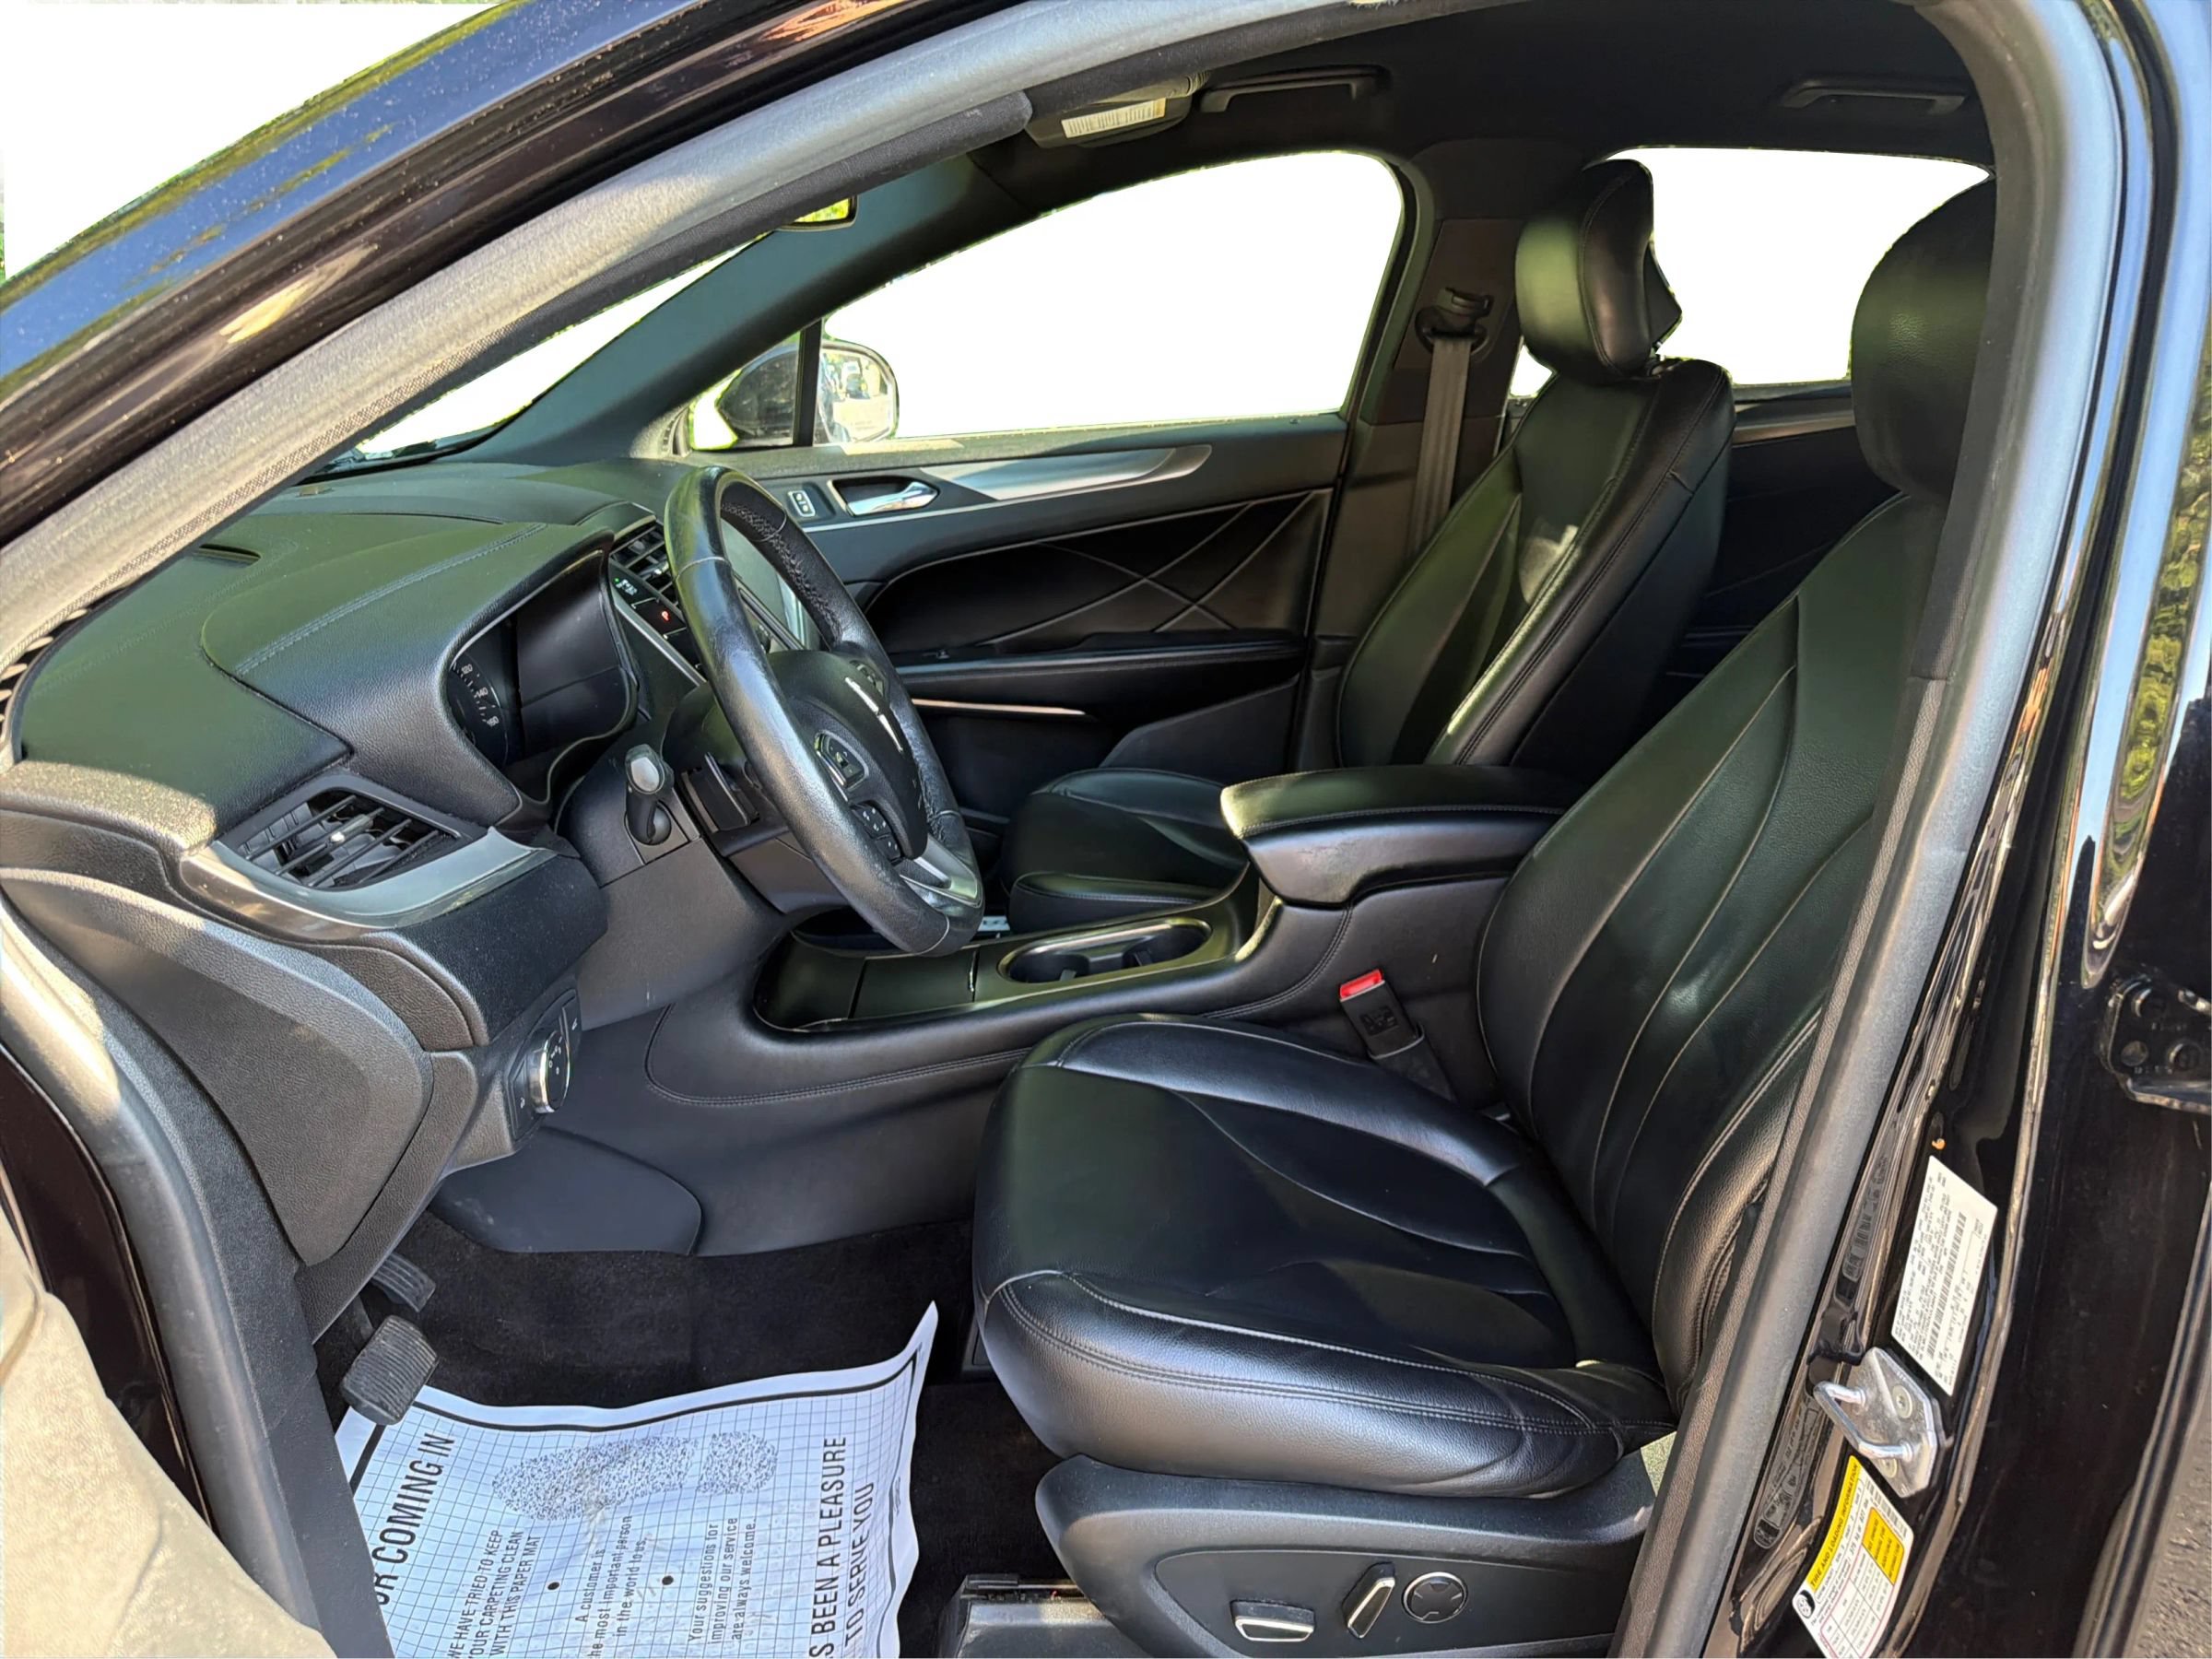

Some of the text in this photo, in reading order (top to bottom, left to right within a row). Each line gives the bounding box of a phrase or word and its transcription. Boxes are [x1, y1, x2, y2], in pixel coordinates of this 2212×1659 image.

[461, 663, 473, 675] 120
[475, 687, 488, 699] 140
[371, 1460, 444, 1564] COMING
[417, 1432, 455, 1458] IN
[818, 1437, 846, 1548] PLEASURE
[484, 1530, 504, 1557] KEEP
[1810, 1568, 1822, 1587] TIRE
[1820, 1551, 1830, 1570] AND
[1829, 1517, 1844, 1552] LOADING
[1841, 1464, 1858, 1518] INFORMATION
[477, 1556, 495, 1573] TO
[575, 1548, 606, 1623] A customer is
[587, 1515, 633, 1657] he most important person
[623, 1566, 641, 1598] world
[629, 1554, 643, 1564] to
[688, 1524, 719, 1642] Your suggestions for
[708, 1517, 738, 1644] improving our service
[732, 1519, 757, 1641] are always welcome.
[817, 1552, 841, 1568] A
[844, 1482, 875, 1648] TO SERVE YOU
[465, 1574, 488, 1606] TRIED
[467, 1531, 524, 1659] OUR CARPETING CLEAN
[488, 1535, 542, 1656] WITH THIS PAPER MAT
[617, 1601, 633, 1621] the
[811, 1577, 841, 1634] BEEN
[453, 1609, 477, 1640] HAVE
[612, 1626, 628, 1637] in
